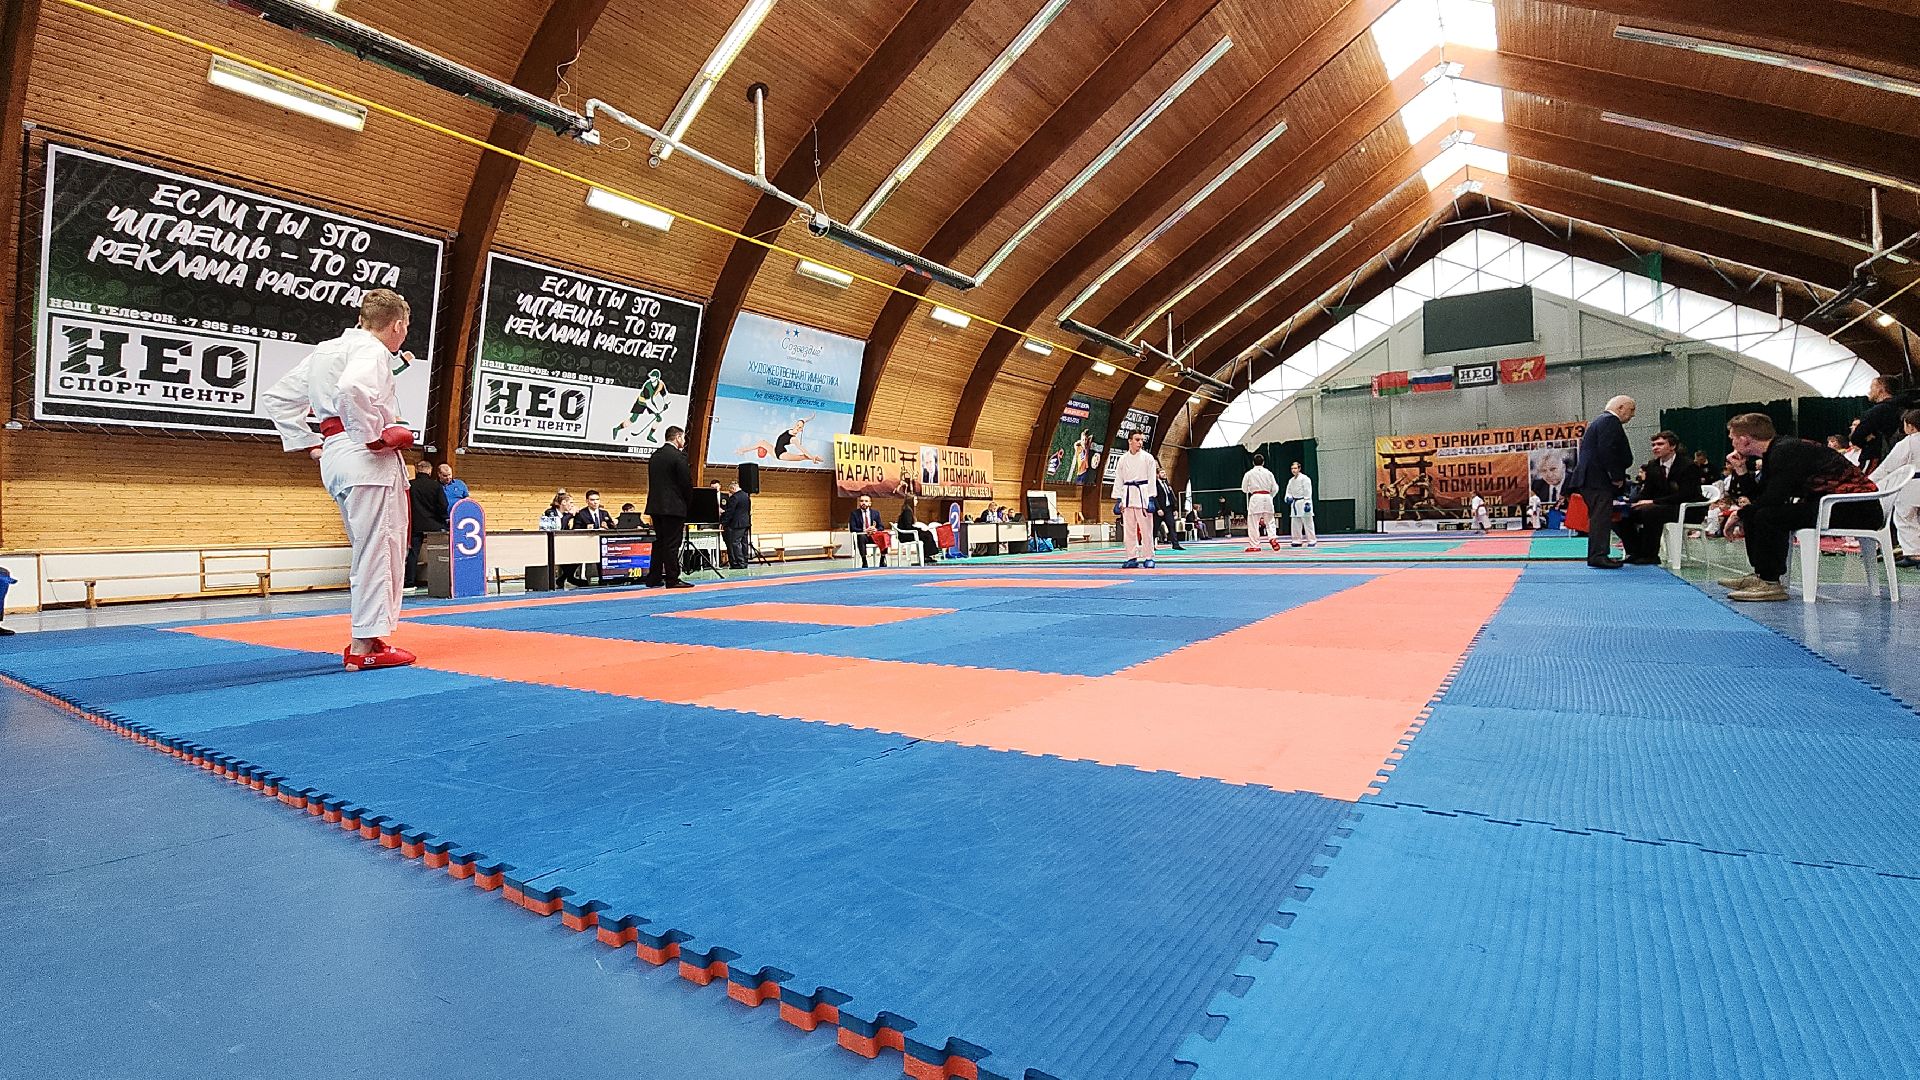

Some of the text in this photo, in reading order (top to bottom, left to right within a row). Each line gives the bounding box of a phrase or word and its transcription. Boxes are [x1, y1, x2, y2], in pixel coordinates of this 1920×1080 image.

[149, 183, 371, 252] ЕСЛИ ТЫ ЭТО
[87, 235, 249, 288] РЕКЛАМА
[106, 205, 271, 262] ЧИТАЕШЬ
[309, 248, 346, 276] ТО
[353, 258, 400, 288] ЭТА
[540, 275, 661, 319] ЕСЛИ ТЫ ЭТО
[182, 318, 198, 327] +7
[202, 320, 229, 332] 985
[232, 324, 258, 336] 294
[262, 329, 278, 339] 79
[281, 332, 298, 341] 97
[516, 293, 605, 329] ЧИТАЕШЬ
[624, 315, 646, 336] ТО
[649, 321, 677, 342] ЭТА
[504, 314, 678, 364] РЕКЛАМА РАБОТАЕТ!
[60, 324, 249, 389] НЕО
[59, 376, 150, 396] СПОРТ
[484, 379, 586, 421] НЕО
[483, 415, 531, 428] СПОРТ
[1433, 425, 1585, 448] ТУРНИР ПО КАРАТЭ
[837, 441, 896, 463] ТУРНИР ПО
[942, 449, 973, 467] ЧТОБЫ
[837, 463, 884, 482] КАРАТЭ
[1438, 462, 1492, 477] ЧТОБЫ
[950, 511, 959, 531] 2
[456, 518, 483, 555] 3
